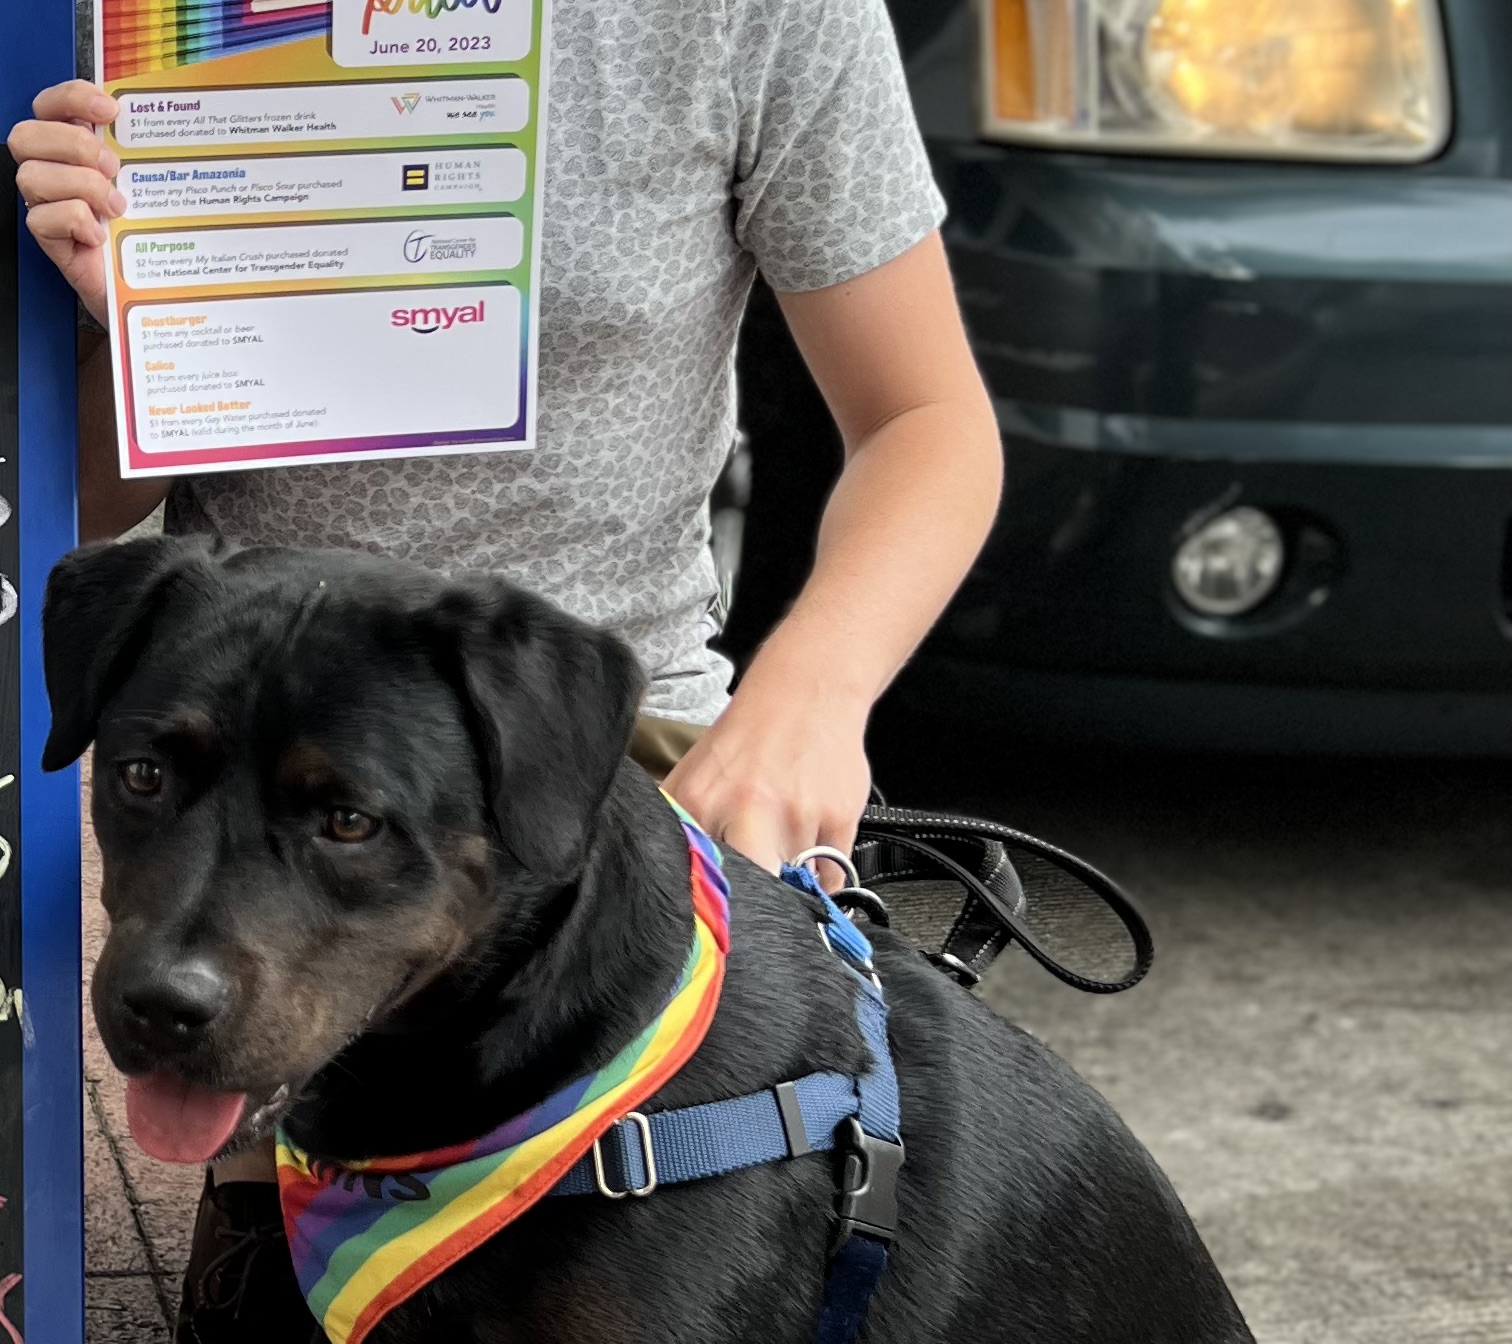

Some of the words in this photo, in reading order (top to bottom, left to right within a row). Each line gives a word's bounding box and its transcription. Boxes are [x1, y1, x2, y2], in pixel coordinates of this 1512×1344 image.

[369, 38, 410, 56] June
[415, 37, 443, 55] 20,
[448, 36, 492, 52] 2023
[130, 101, 155, 113] Lost
[157, 101, 165, 113] &
[167, 100, 201, 112] Found
[130, 118, 141, 128] $1
[143, 117, 165, 127] from
[166, 118, 191, 127] every
[193, 116, 206, 125] All
[208, 115, 227, 124] That
[229, 114, 262, 124] Glitters
[264, 113, 292, 122] frozen
[294, 111, 317, 121] drink
[130, 128, 176, 141] purchased
[178, 127, 215, 137] donated
[217, 127, 227, 136] to
[228, 126, 270, 134] Whitman
[272, 123, 304, 133] Walker
[306, 121, 337, 131] Health
[435, 160, 482, 170] HUMAN
[131, 170, 190, 183] Causa/Bar
[191, 167, 246, 180] Amazonia
[434, 172, 481, 181] RIGHTS
[132, 188, 143, 197] $2
[145, 187, 166, 196] from
[168, 188, 183, 197] any
[185, 186, 208, 195] Pisco
[209, 184, 237, 193] Punch
[250, 183, 273, 192] Pisco
[275, 181, 296, 190] Sour
[297, 179, 343, 191] purchased
[133, 199, 168, 209] donated
[170, 199, 180, 207] to
[182, 197, 197, 206] the
[198, 196, 230, 205] Human
[233, 195, 261, 205] Rights
[264, 193, 309, 203] Campaign
[135, 242, 148, 253] All
[150, 241, 195, 253] Purpose
[430, 249, 476, 260] EQUALITY
[148, 257, 168, 266] from
[169, 257, 193, 266] every
[195, 255, 209, 265] My
[239, 252, 264, 261] Crush
[266, 249, 310, 261] purchased
[312, 247, 349, 258] donated
[137, 271, 146, 279] to
[148, 270, 161, 278] the
[163, 267, 200, 277] National
[202, 265, 232, 275] Center
[235, 264, 248, 273] for
[250, 262, 306, 273] Transgender
[308, 260, 344, 270] Equality
[391, 300, 485, 330] smyal
[153, 329, 173, 338] from
[143, 341, 184, 353] purchased
[185, 338, 219, 348] donated
[232, 335, 264, 345] SMYAL
[234, 378, 265, 388] SMYAL
